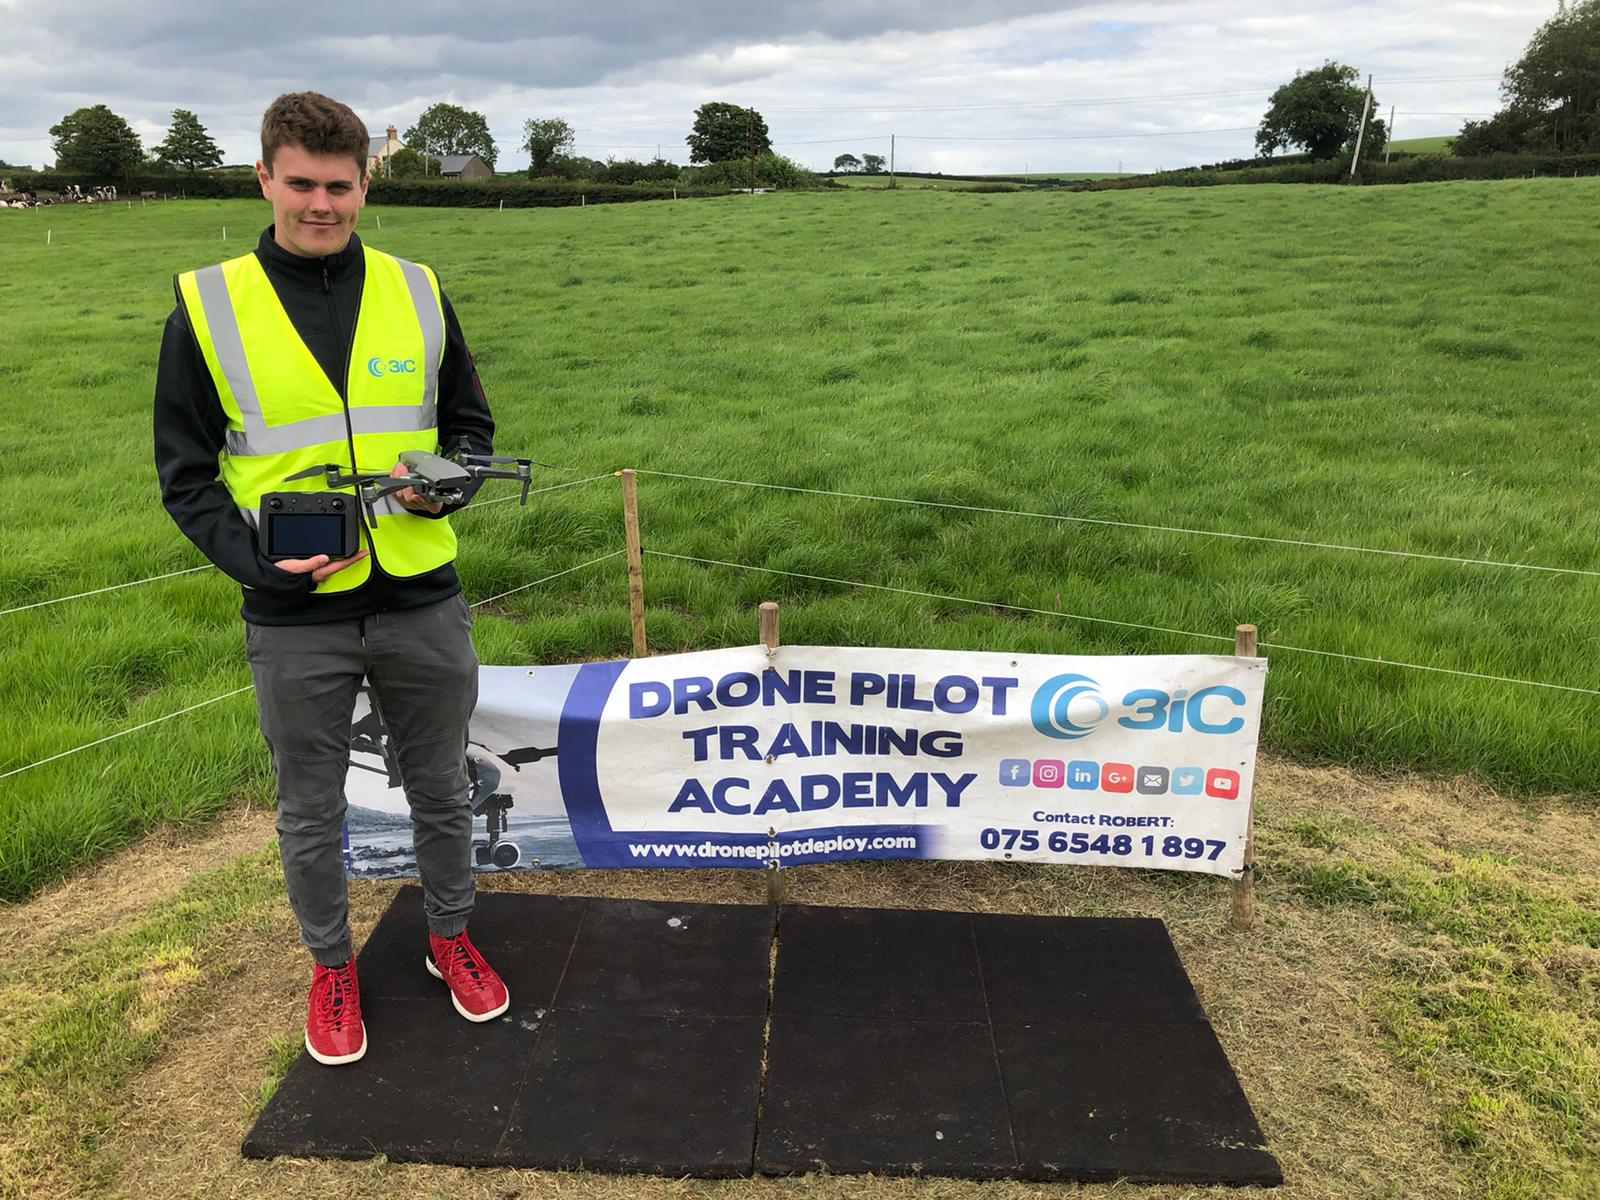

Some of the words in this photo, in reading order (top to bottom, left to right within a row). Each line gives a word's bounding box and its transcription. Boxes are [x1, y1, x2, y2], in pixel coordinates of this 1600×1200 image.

[388, 359, 416, 373] 3iC
[629, 669, 836, 720] DRONE
[850, 672, 1019, 716] PILOT
[1117, 685, 1246, 735] 3iC
[682, 721, 963, 762] TRAINING
[668, 772, 977, 815] ACADEMY
[1032, 811, 1096, 826] Contact
[1099, 814, 1175, 828] ROBERT:
[629, 835, 916, 862] www.dronepilotdeploy.com
[980, 828, 1040, 851] 075
[1048, 832, 1133, 856] 6548
